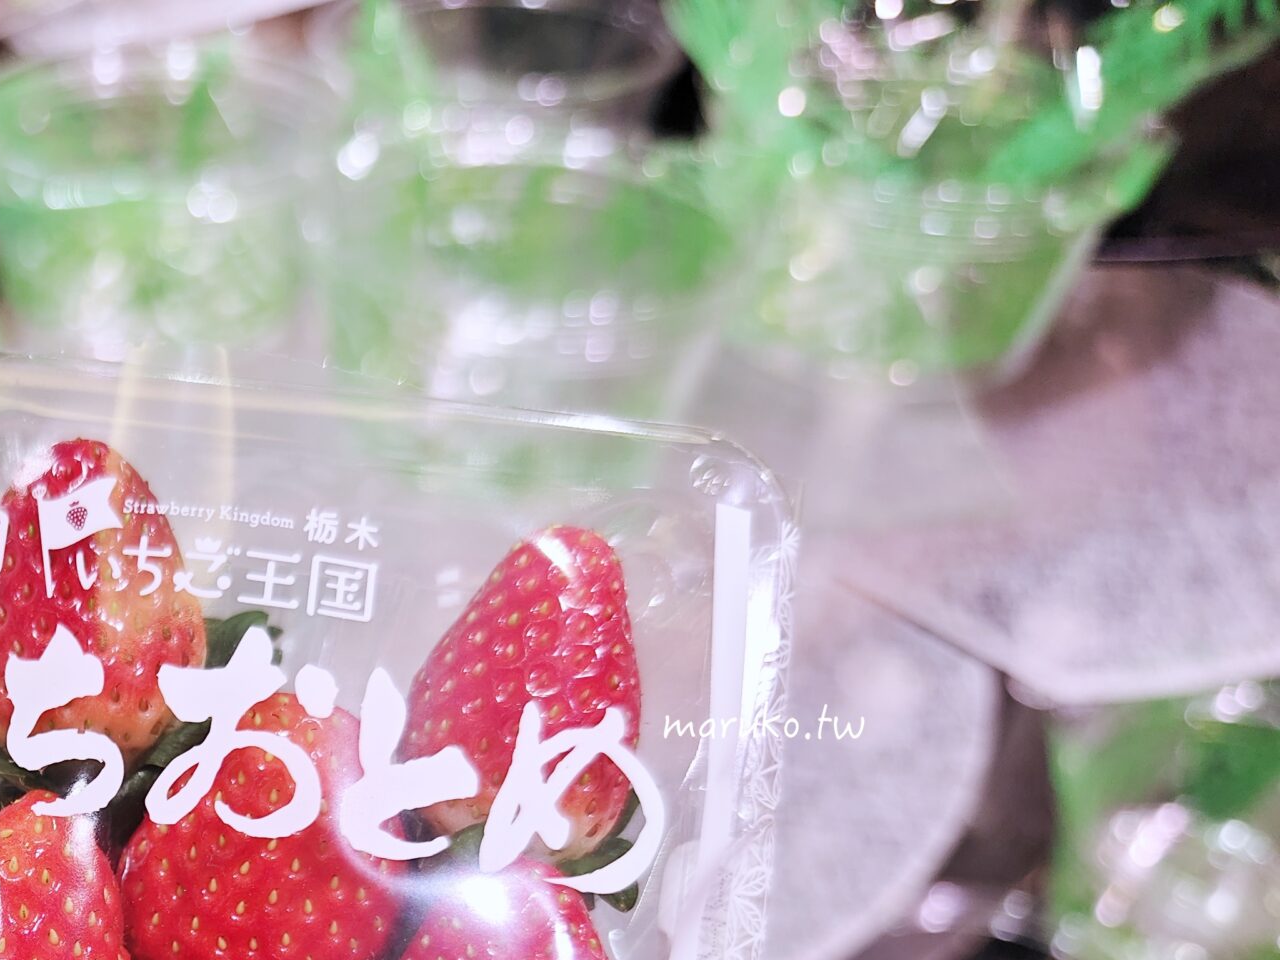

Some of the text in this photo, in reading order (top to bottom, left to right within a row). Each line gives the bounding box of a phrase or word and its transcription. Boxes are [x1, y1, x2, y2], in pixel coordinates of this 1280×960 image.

[123, 499, 295, 531] Strawberry Kingdom
[303, 508, 381, 551] 栃木
[76, 536, 379, 623] いちご王国
